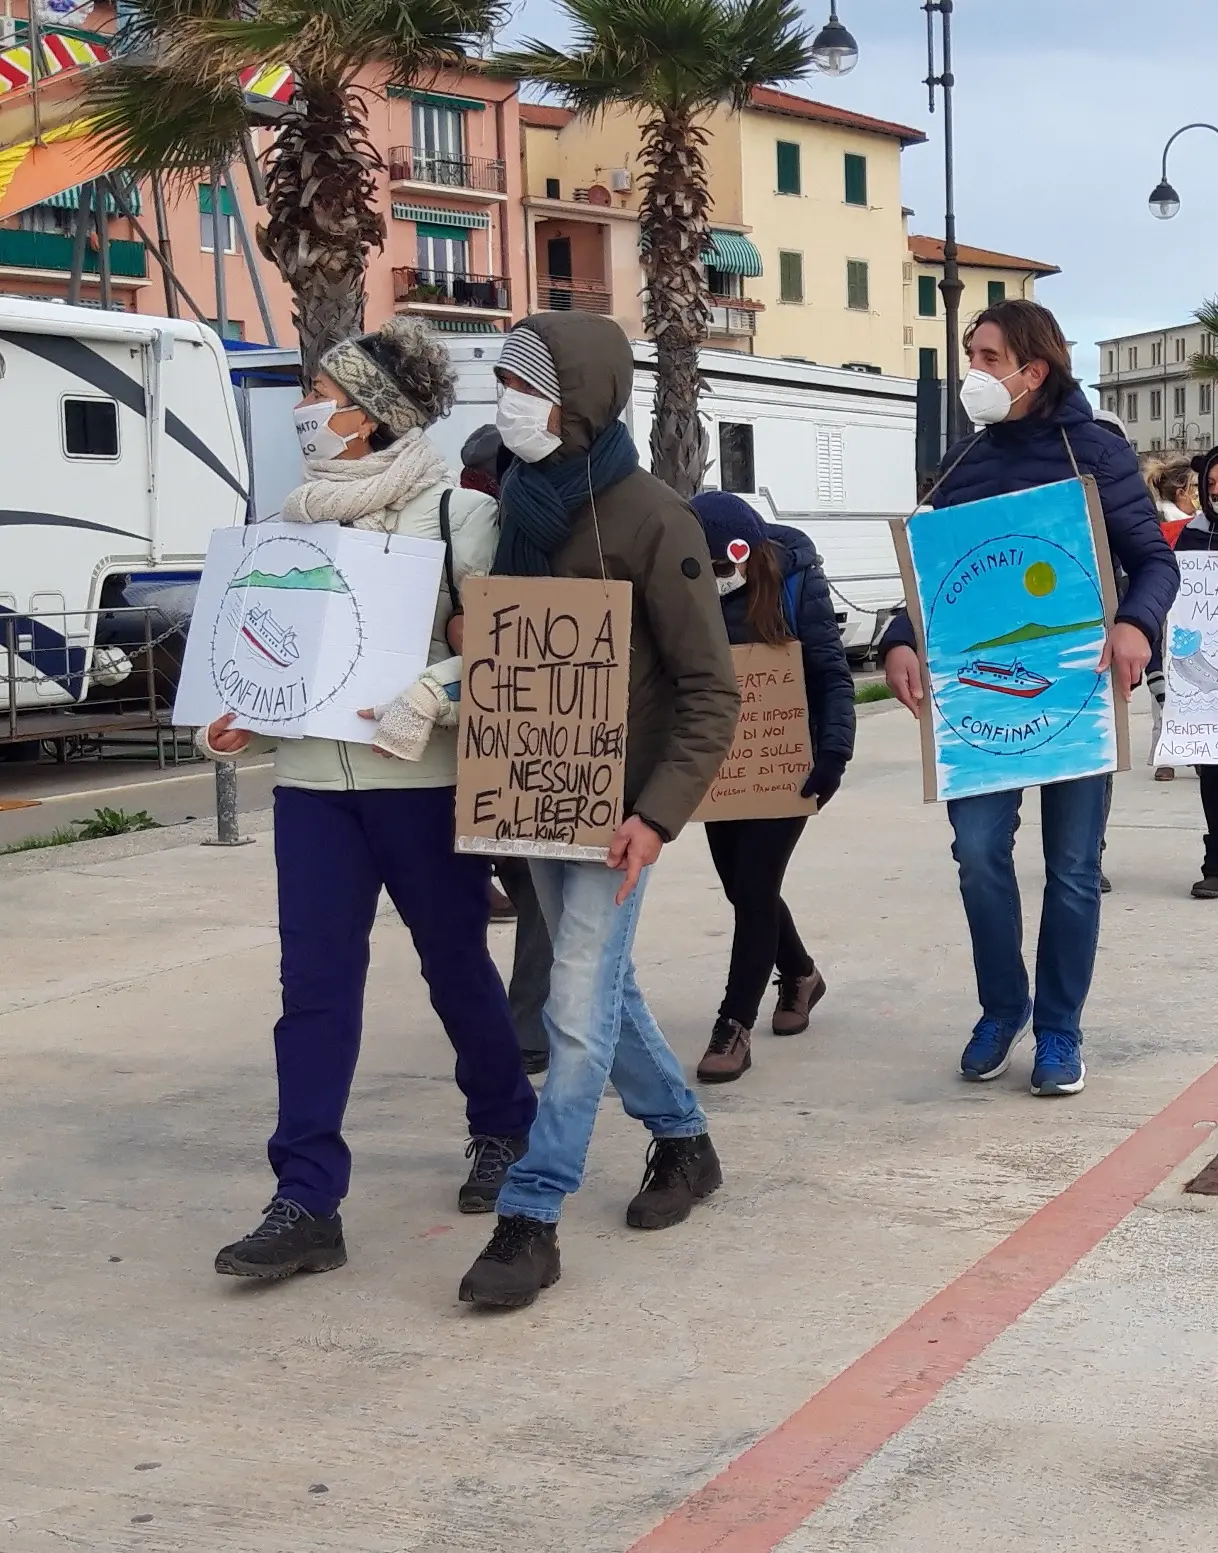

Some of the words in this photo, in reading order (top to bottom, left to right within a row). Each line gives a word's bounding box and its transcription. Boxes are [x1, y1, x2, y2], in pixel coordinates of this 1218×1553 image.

[946, 546, 1024, 605] CONFINATI
[489, 605, 580, 660] FINO
[591, 609, 616, 660] A
[219, 659, 308, 715] CONFINATI
[469, 659, 538, 714] CHE
[538, 658, 619, 721] TUTTI
[763, 707, 806, 721] IMPOSTE
[961, 709, 1050, 744] CONFINATI
[465, 715, 511, 759] NON
[513, 721, 568, 758] SONO
[743, 728, 757, 740] DI
[762, 725, 785, 738] NOI
[760, 743, 804, 758] SULLE
[1159, 740, 1212, 758] NOSTRA
[510, 760, 612, 796] NESSUNO
[757, 763, 774, 775] DI
[779, 760, 811, 774] TUTTI
[514, 796, 619, 832] LIBERO!
